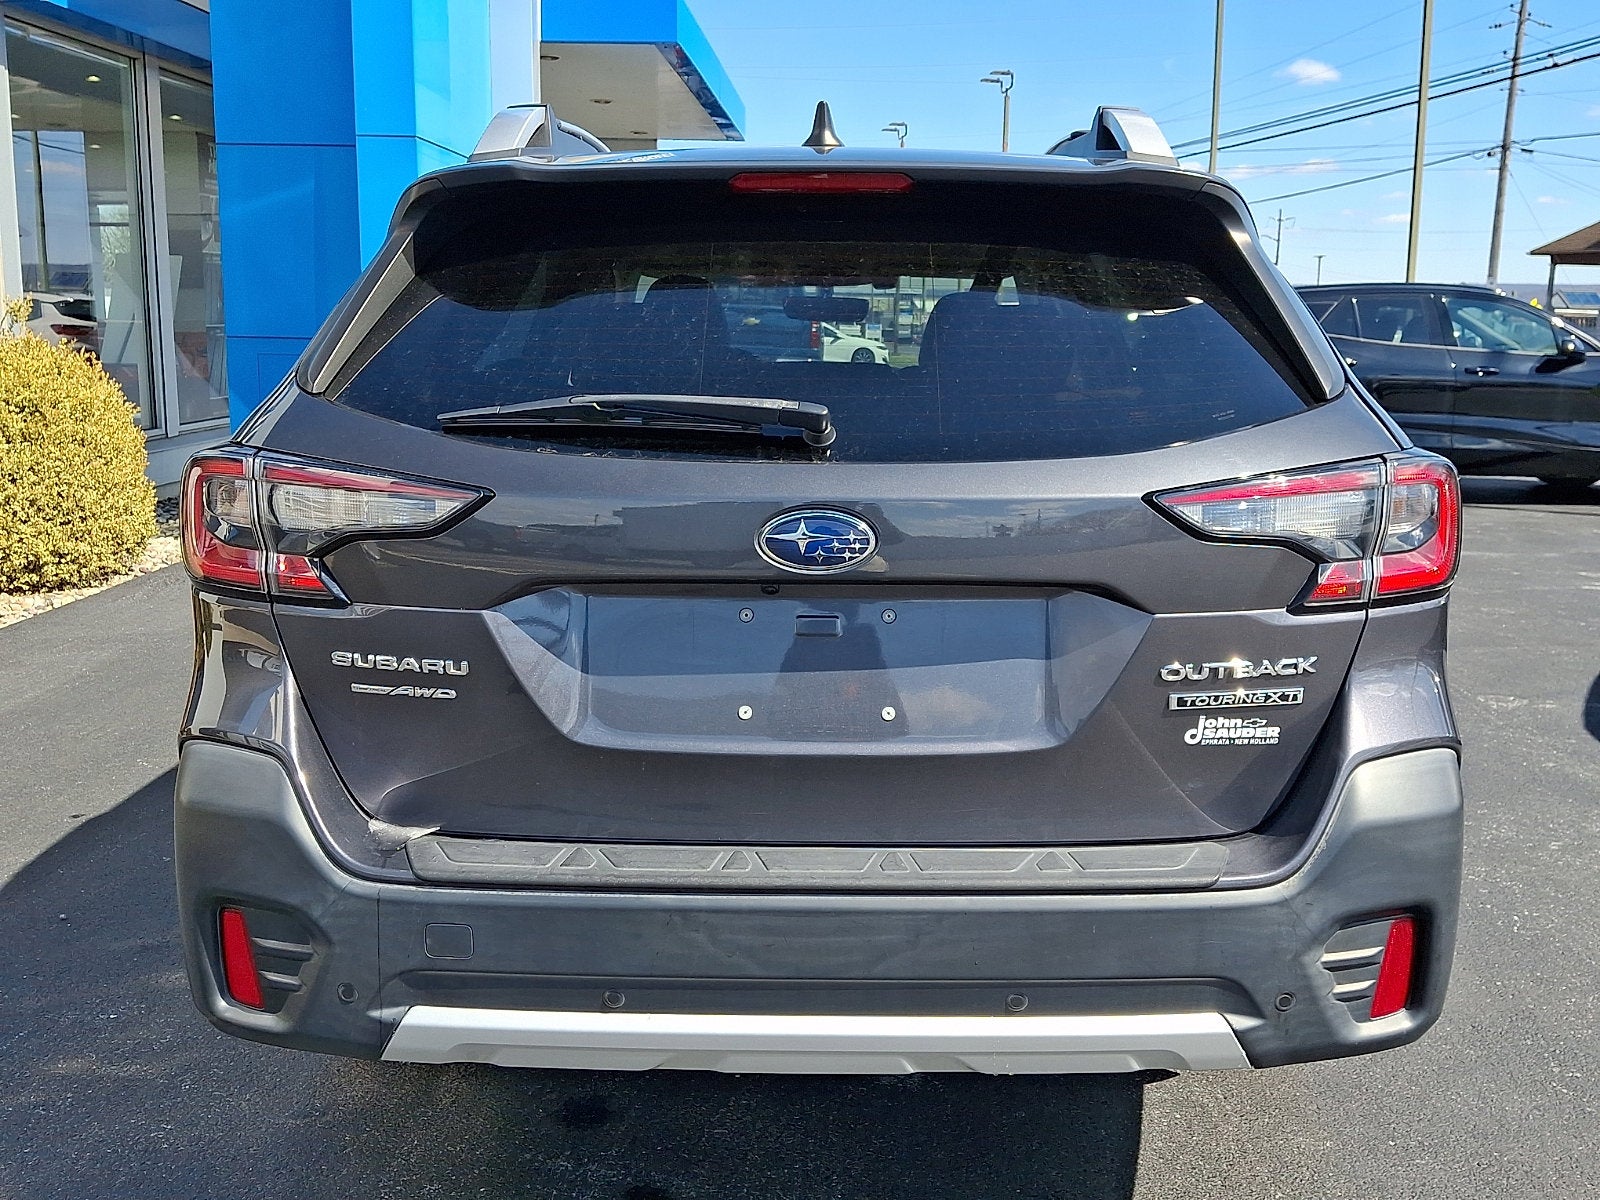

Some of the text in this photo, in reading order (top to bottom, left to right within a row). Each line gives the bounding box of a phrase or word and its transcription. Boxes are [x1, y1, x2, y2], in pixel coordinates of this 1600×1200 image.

[331, 651, 469, 676] SUBARU
[1160, 656, 1318, 682] OUTBACK
[389, 686, 457, 699] AWD
[1203, 726, 1281, 739] SAUDER
[1201, 738, 1230, 746] EPHRATA
[1249, 737, 1279, 745] HOLLAND
